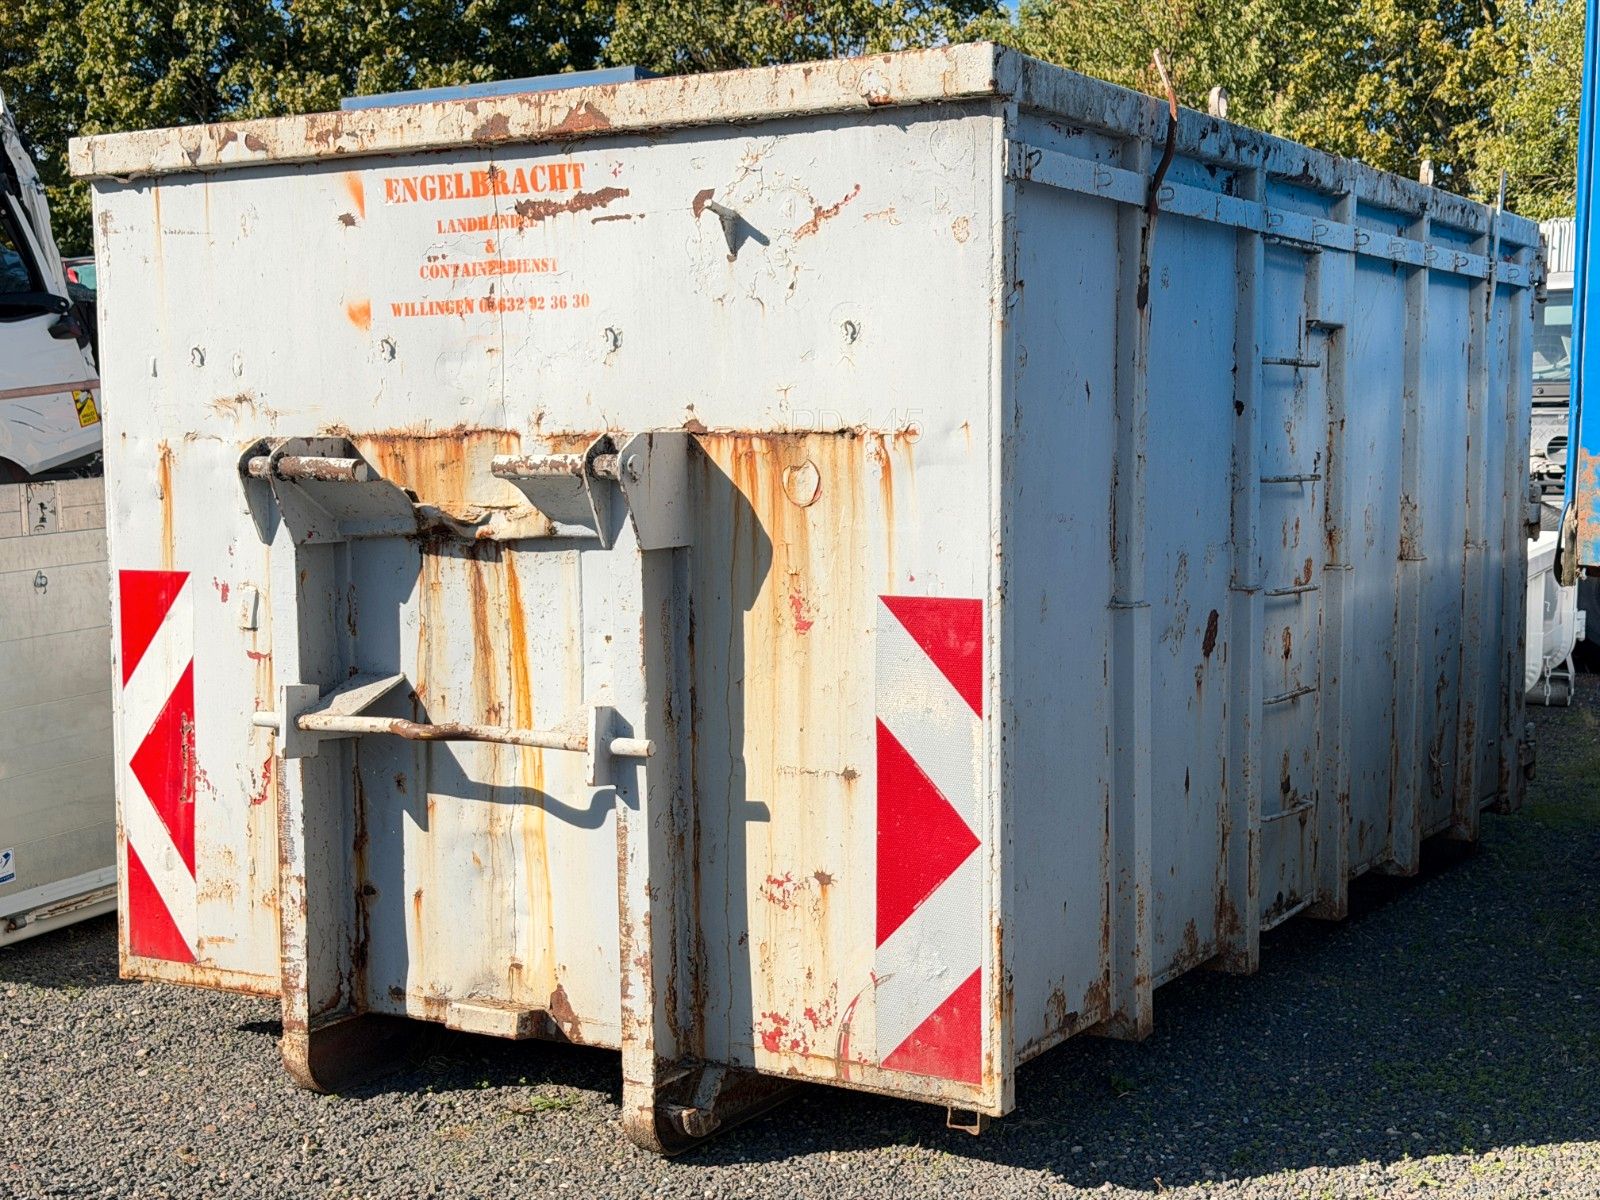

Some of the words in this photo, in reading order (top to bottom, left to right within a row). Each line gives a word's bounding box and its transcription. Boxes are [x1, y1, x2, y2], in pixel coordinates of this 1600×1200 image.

[384, 163, 585, 203] ENGELBRACHT
[437, 214, 537, 234] LANDHANDL
[484, 238, 497, 254] &
[419, 258, 559, 280] CONTAINERDIENST
[391, 299, 475, 318] WILLINGEN
[529, 296, 545, 310] 92
[550, 294, 567, 309] 36
[572, 292, 590, 308] 30
